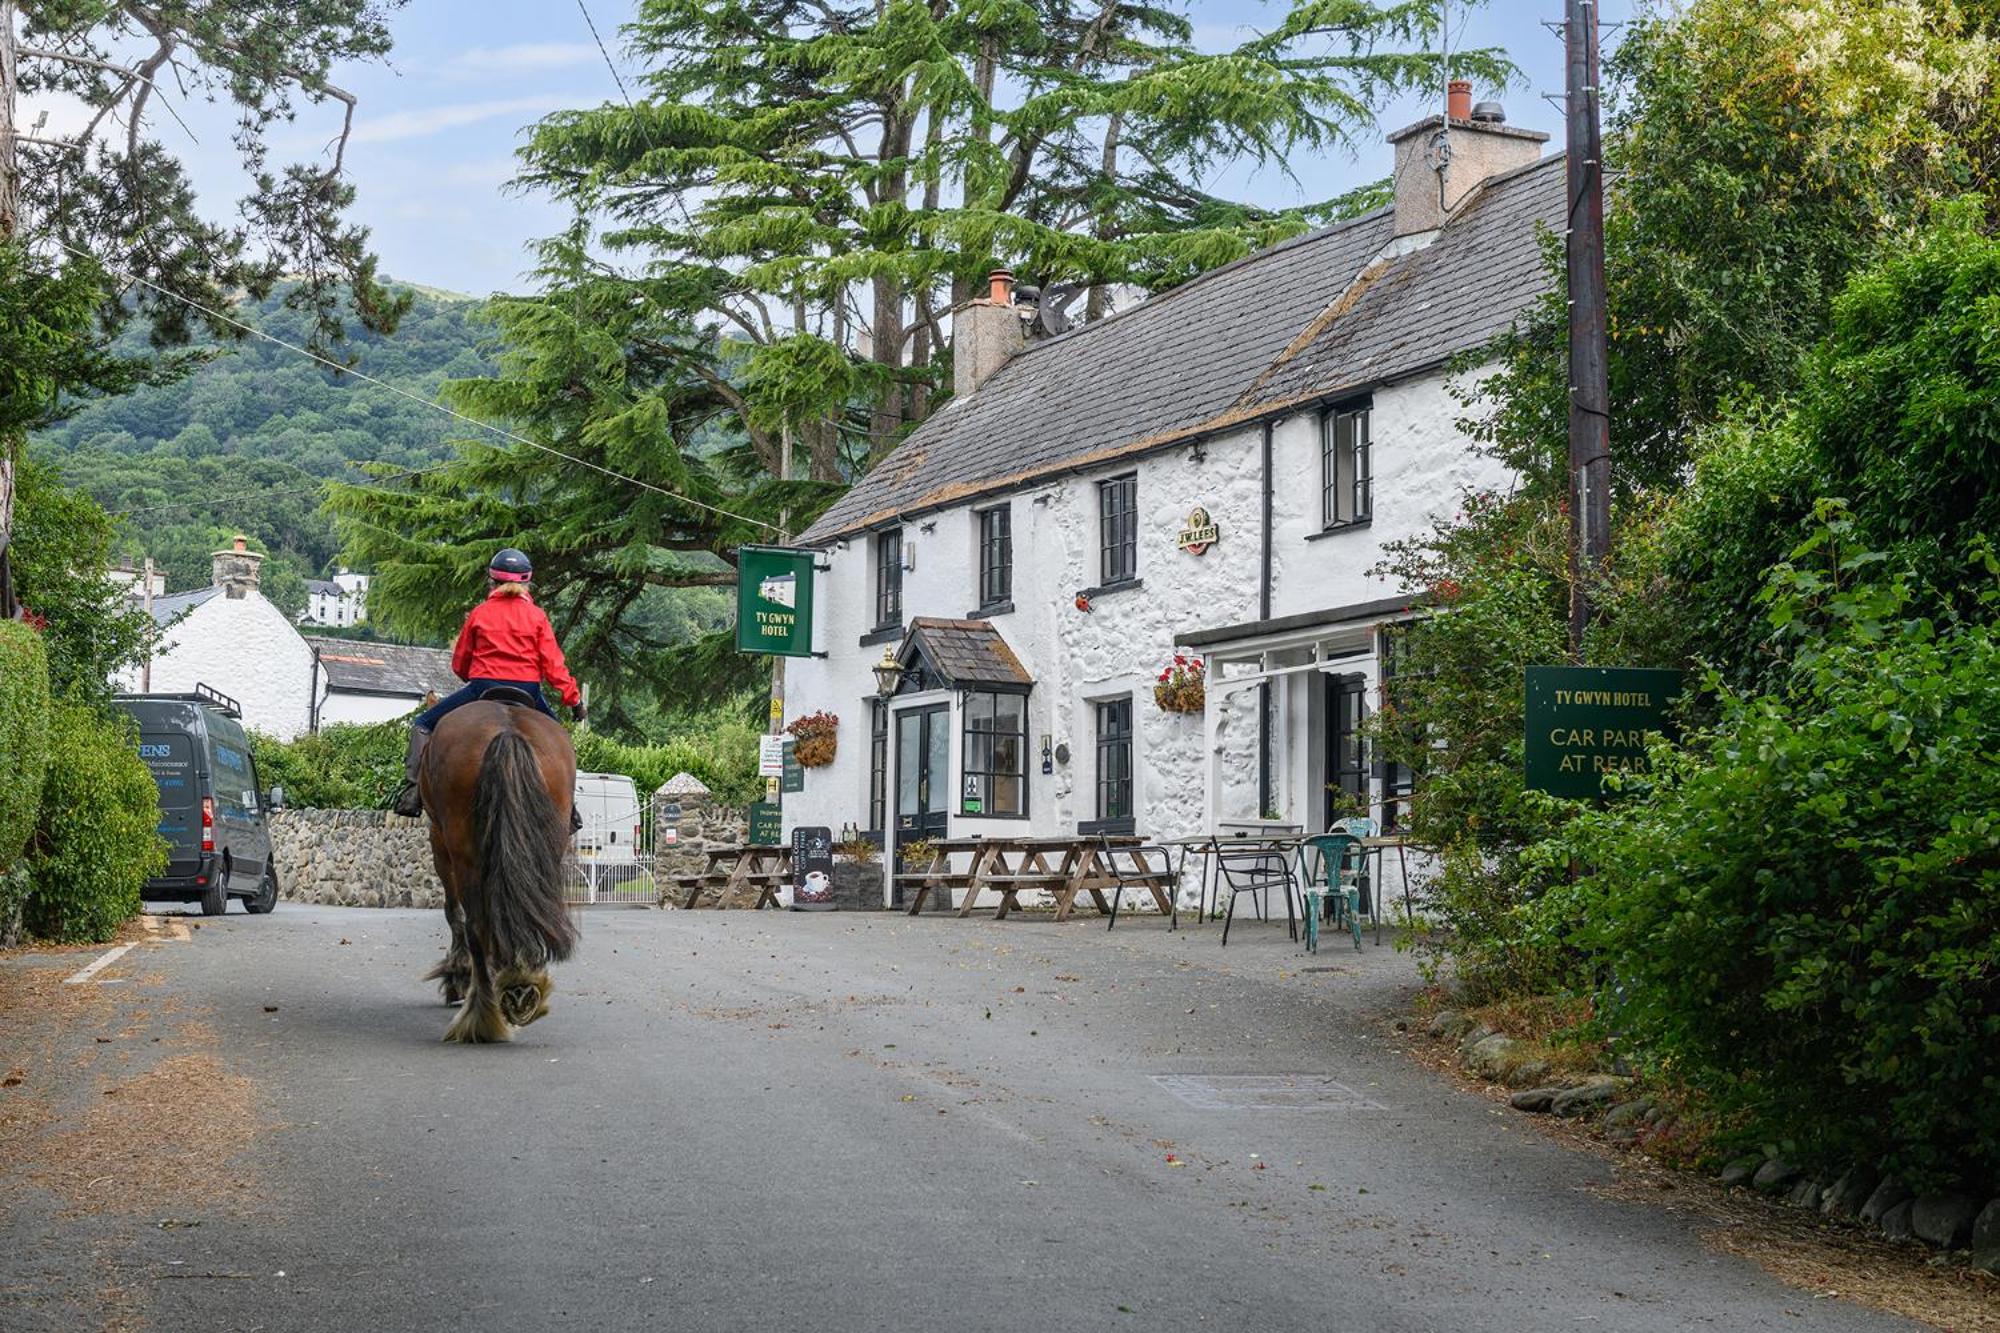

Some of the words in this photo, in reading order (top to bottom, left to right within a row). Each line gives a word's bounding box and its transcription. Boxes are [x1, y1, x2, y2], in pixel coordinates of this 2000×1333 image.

[756, 611, 767, 623] TY
[768, 612, 795, 625] GWYN
[761, 624, 788, 637] HOTEL
[1555, 690, 1572, 705] TY
[1574, 690, 1611, 706] GWYN
[1613, 691, 1651, 707] HOTEL
[1550, 728, 1595, 747] CAR
[140, 744, 171, 757] ENS
[1559, 754, 1587, 773] AT
